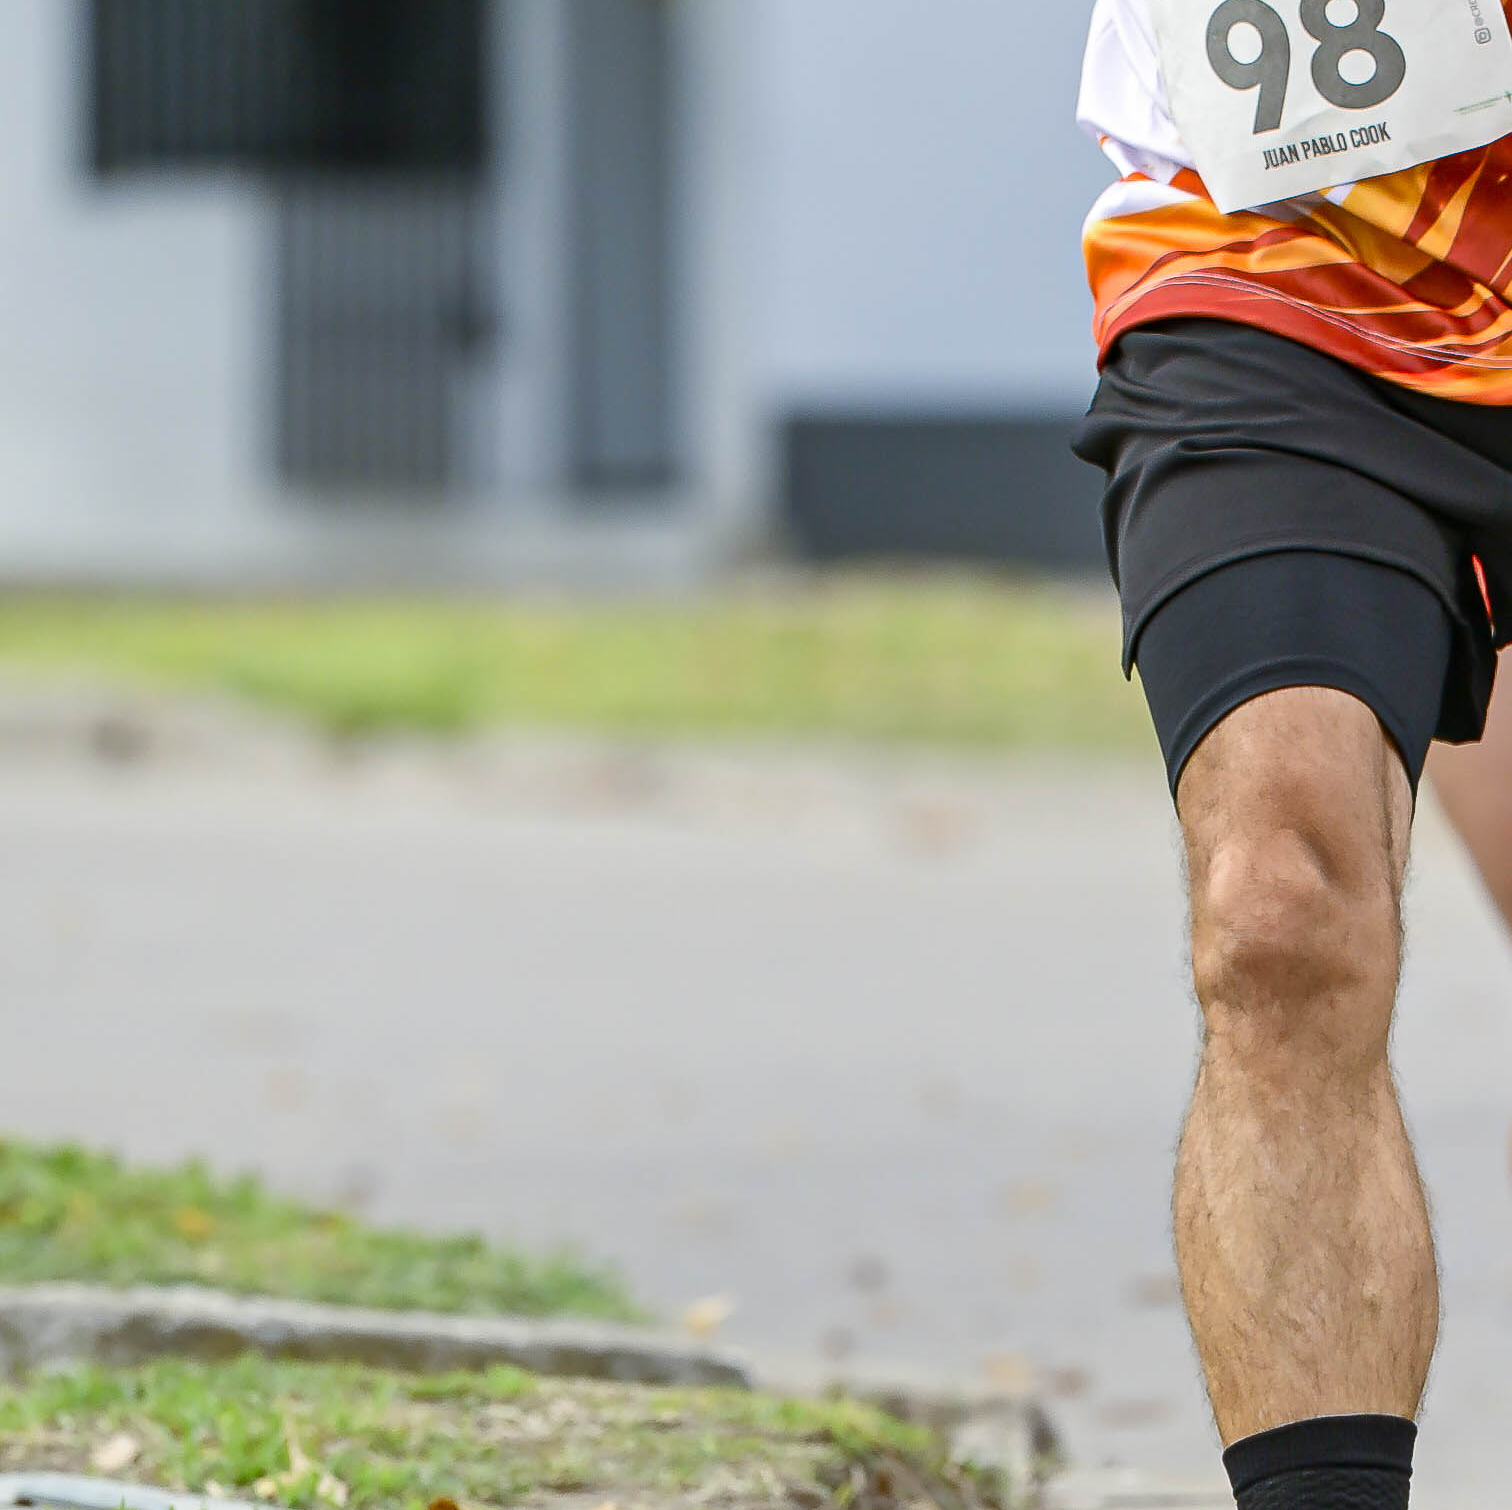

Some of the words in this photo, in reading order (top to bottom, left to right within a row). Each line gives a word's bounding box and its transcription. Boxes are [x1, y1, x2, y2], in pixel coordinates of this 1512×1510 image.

[1262, 143, 1301, 170] JUAN
[1301, 132, 1348, 160] PABLO
[1349, 121, 1391, 148] COOK
